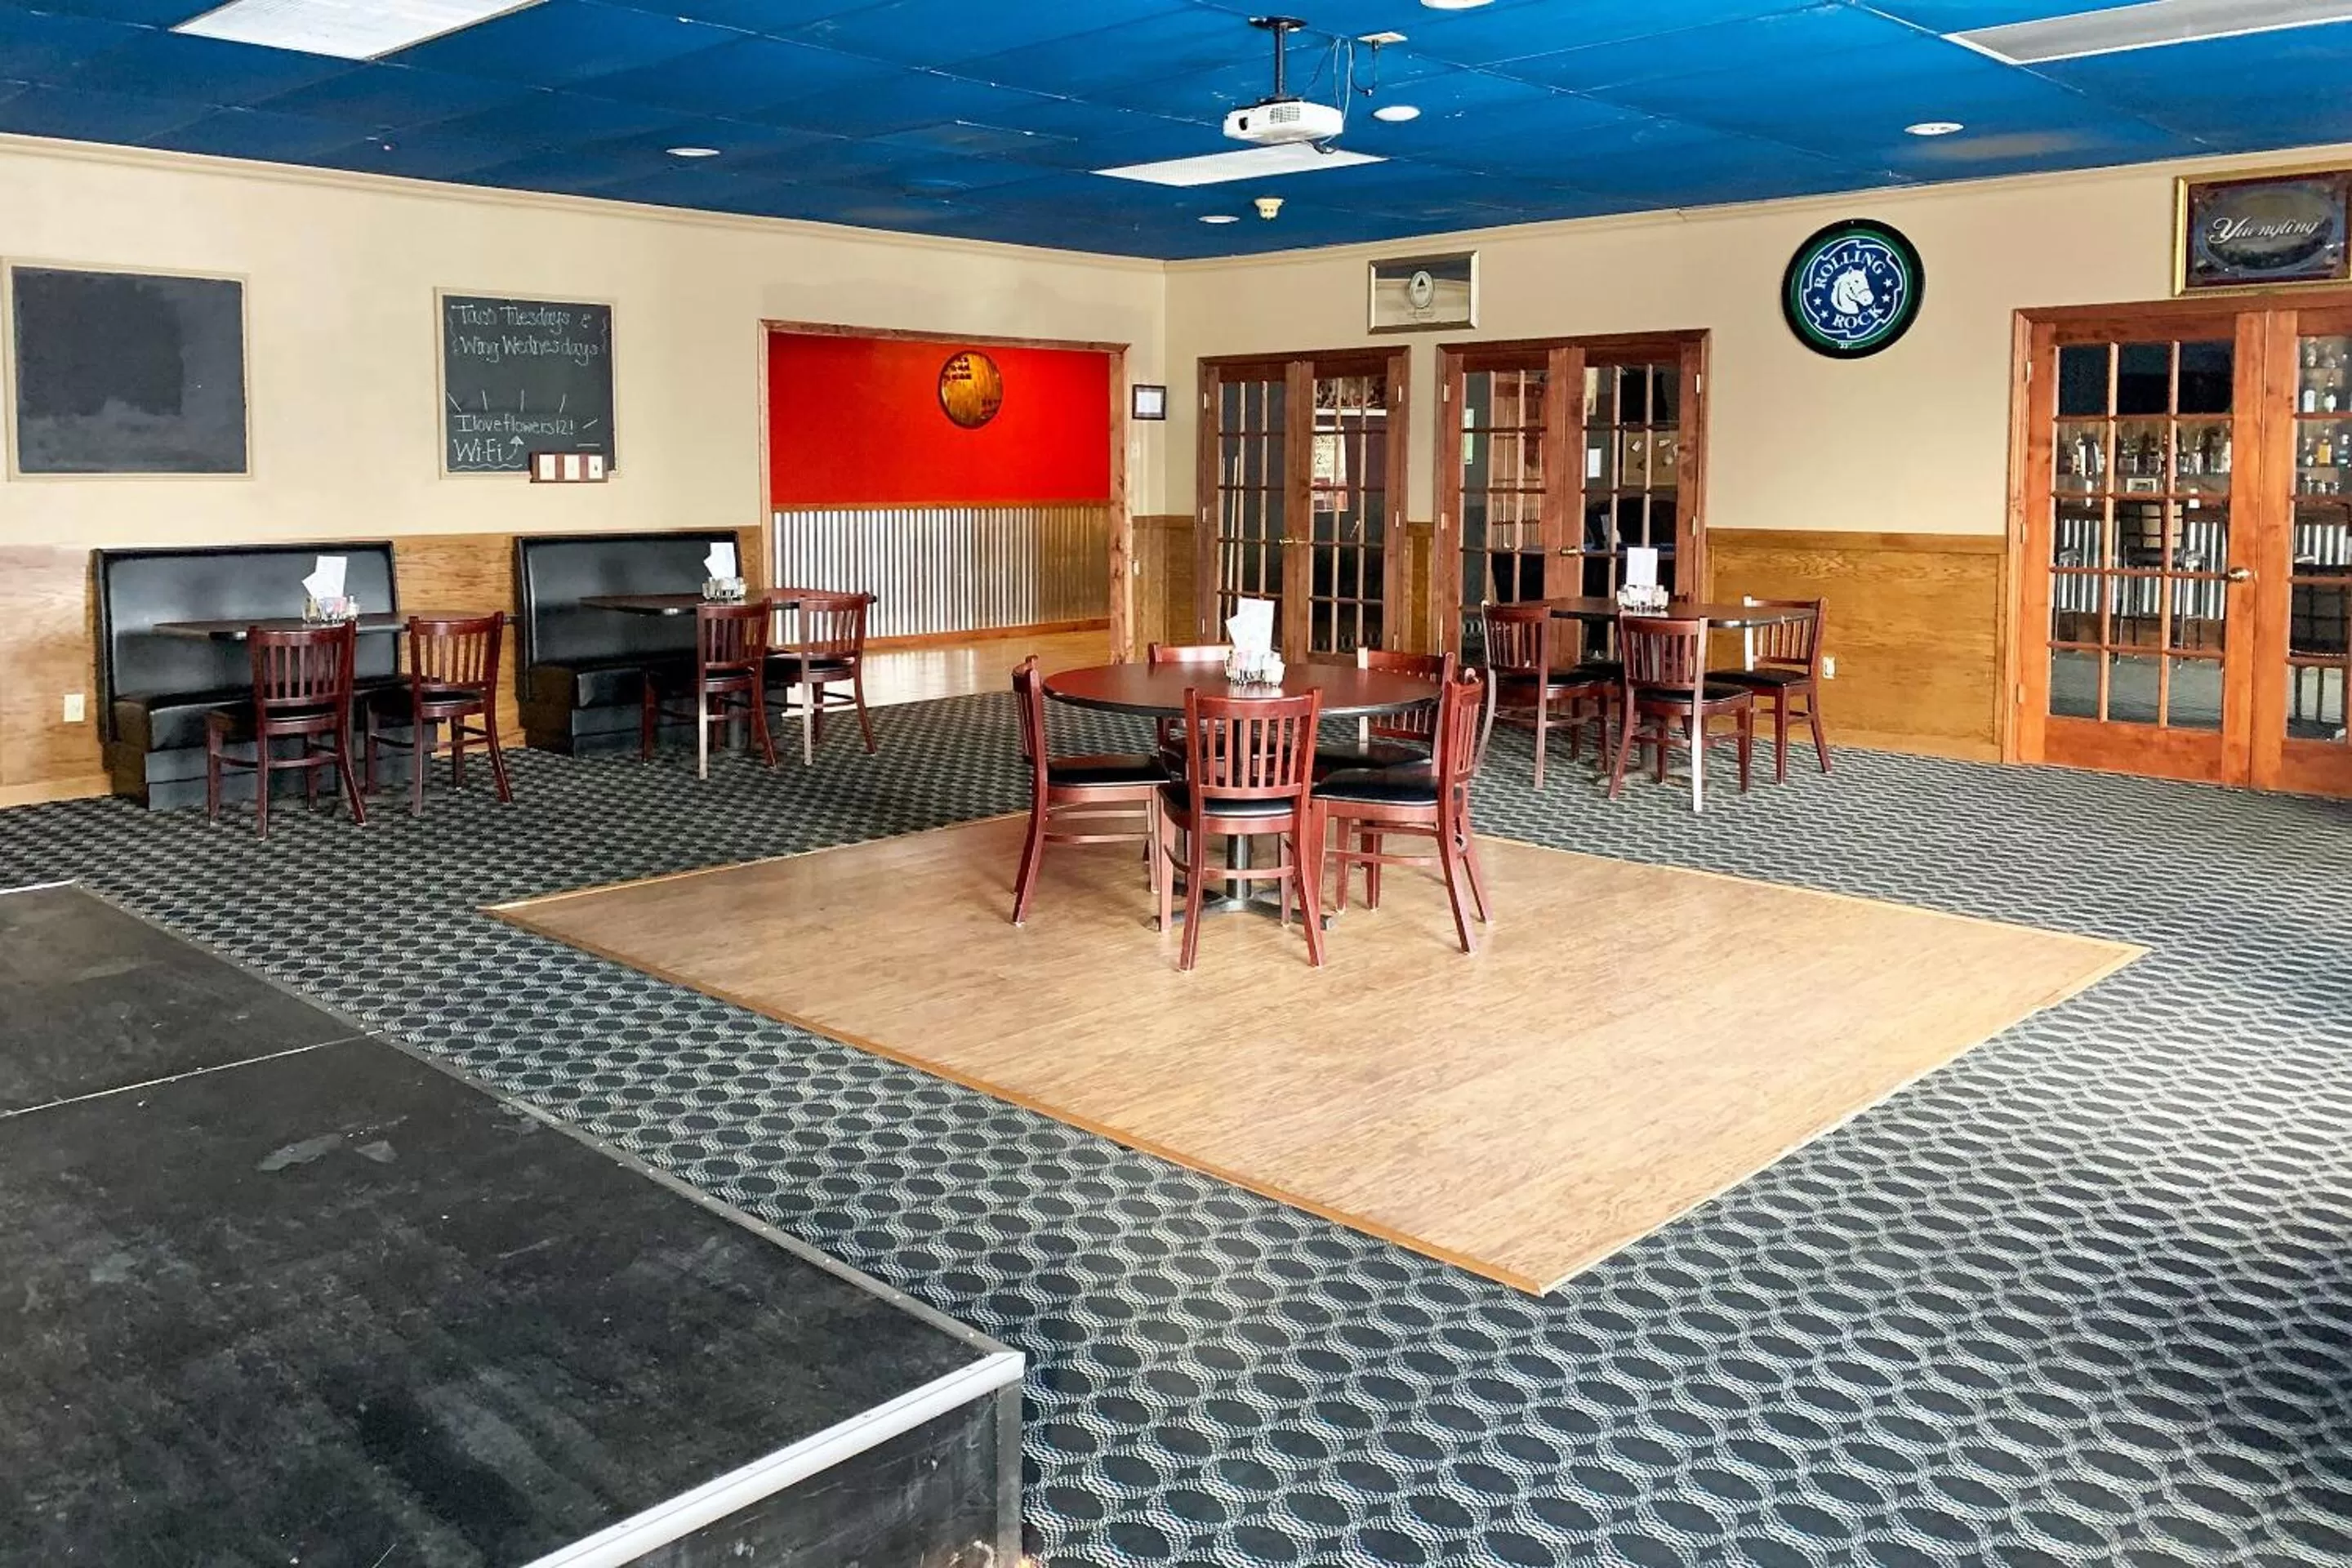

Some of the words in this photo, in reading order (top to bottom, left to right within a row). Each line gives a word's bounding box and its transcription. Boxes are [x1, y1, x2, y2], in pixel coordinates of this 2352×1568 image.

[1814, 250, 1886, 289] ROLLING
[451, 304, 497, 326] Taco
[499, 305, 571, 335] Tuesdays
[1832, 303, 1884, 329] ROCK
[459, 336, 500, 363] Wing
[501, 335, 599, 366] Wednesdays
